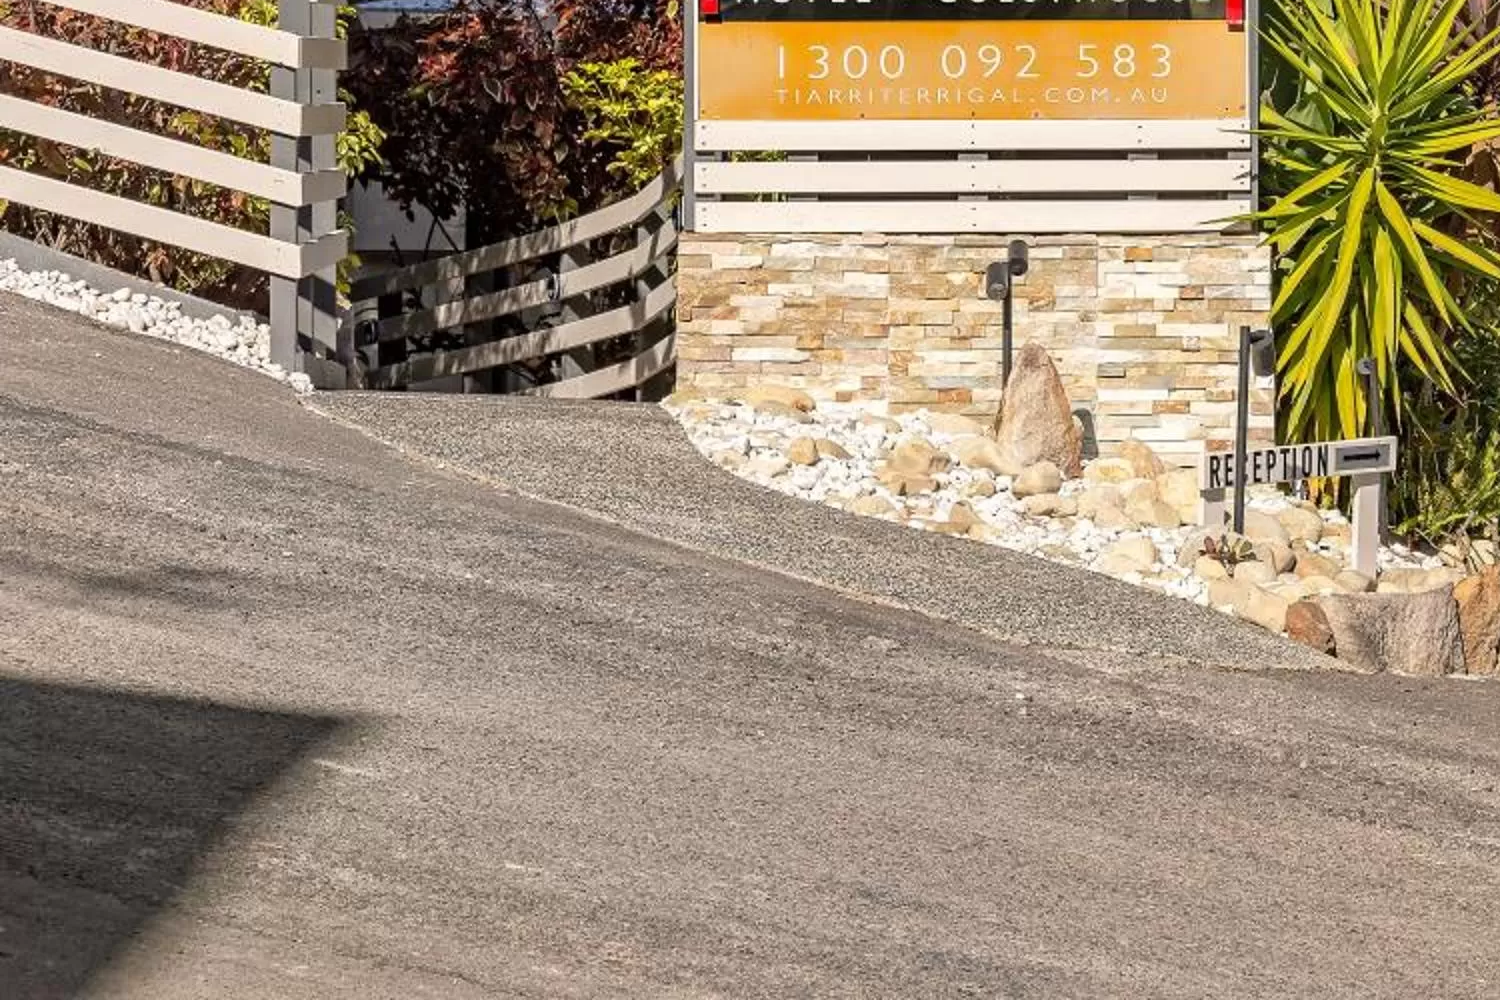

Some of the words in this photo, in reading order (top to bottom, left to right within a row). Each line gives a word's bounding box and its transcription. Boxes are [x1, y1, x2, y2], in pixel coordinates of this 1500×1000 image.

[774, 44, 906, 79] 1300
[940, 43, 1041, 78] 092
[1075, 43, 1172, 78] 583
[773, 86, 1170, 106] TIARRITERRIGAL.COM.AU
[1209, 444, 1329, 487] REEPTION
